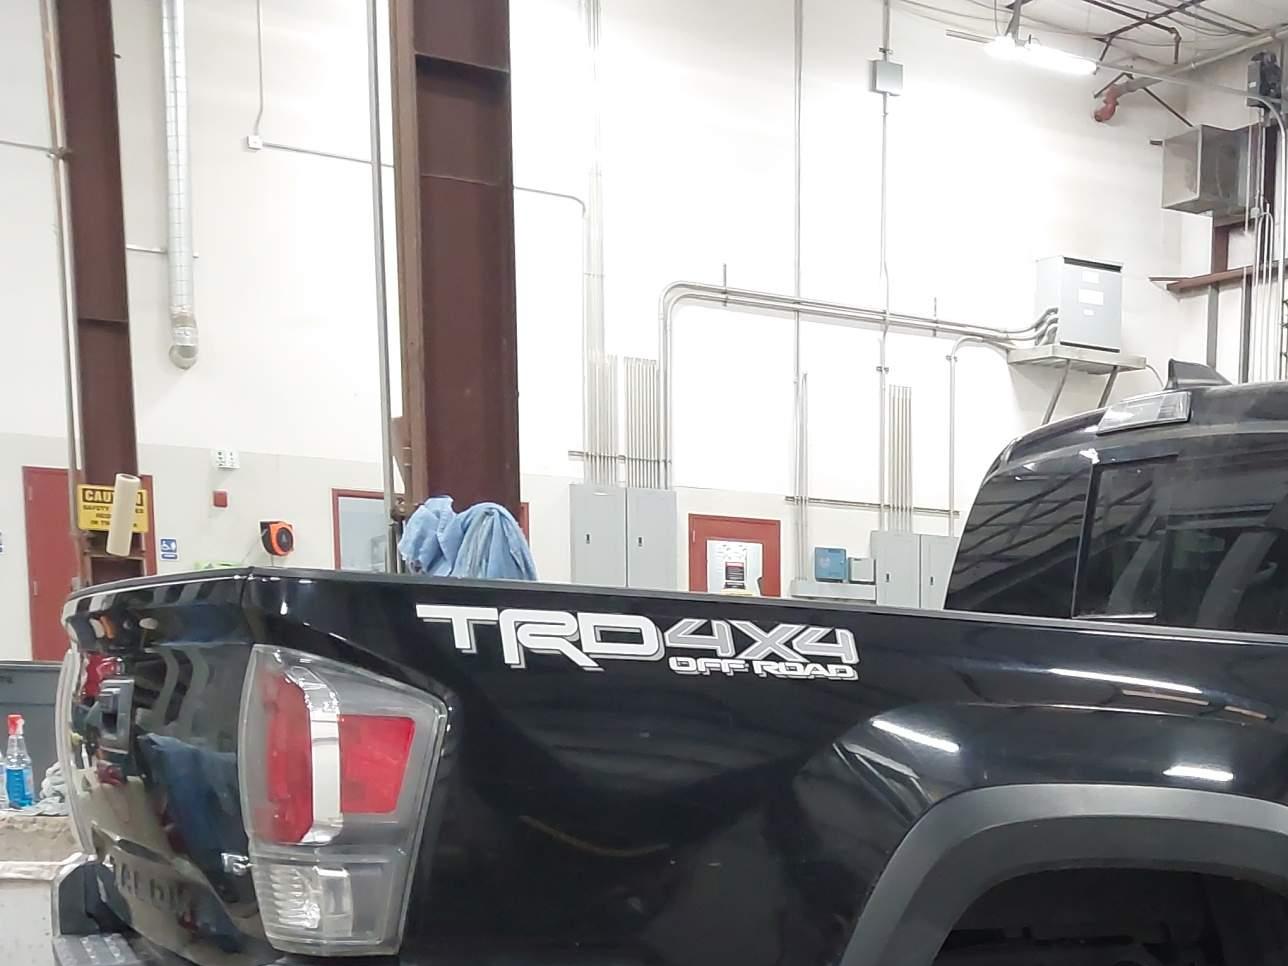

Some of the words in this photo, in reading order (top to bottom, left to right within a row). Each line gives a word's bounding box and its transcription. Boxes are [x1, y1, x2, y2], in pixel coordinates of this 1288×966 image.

[416, 604, 665, 671] TRD
[669, 656, 750, 676] OFF
[753, 660, 859, 681] ROAD
